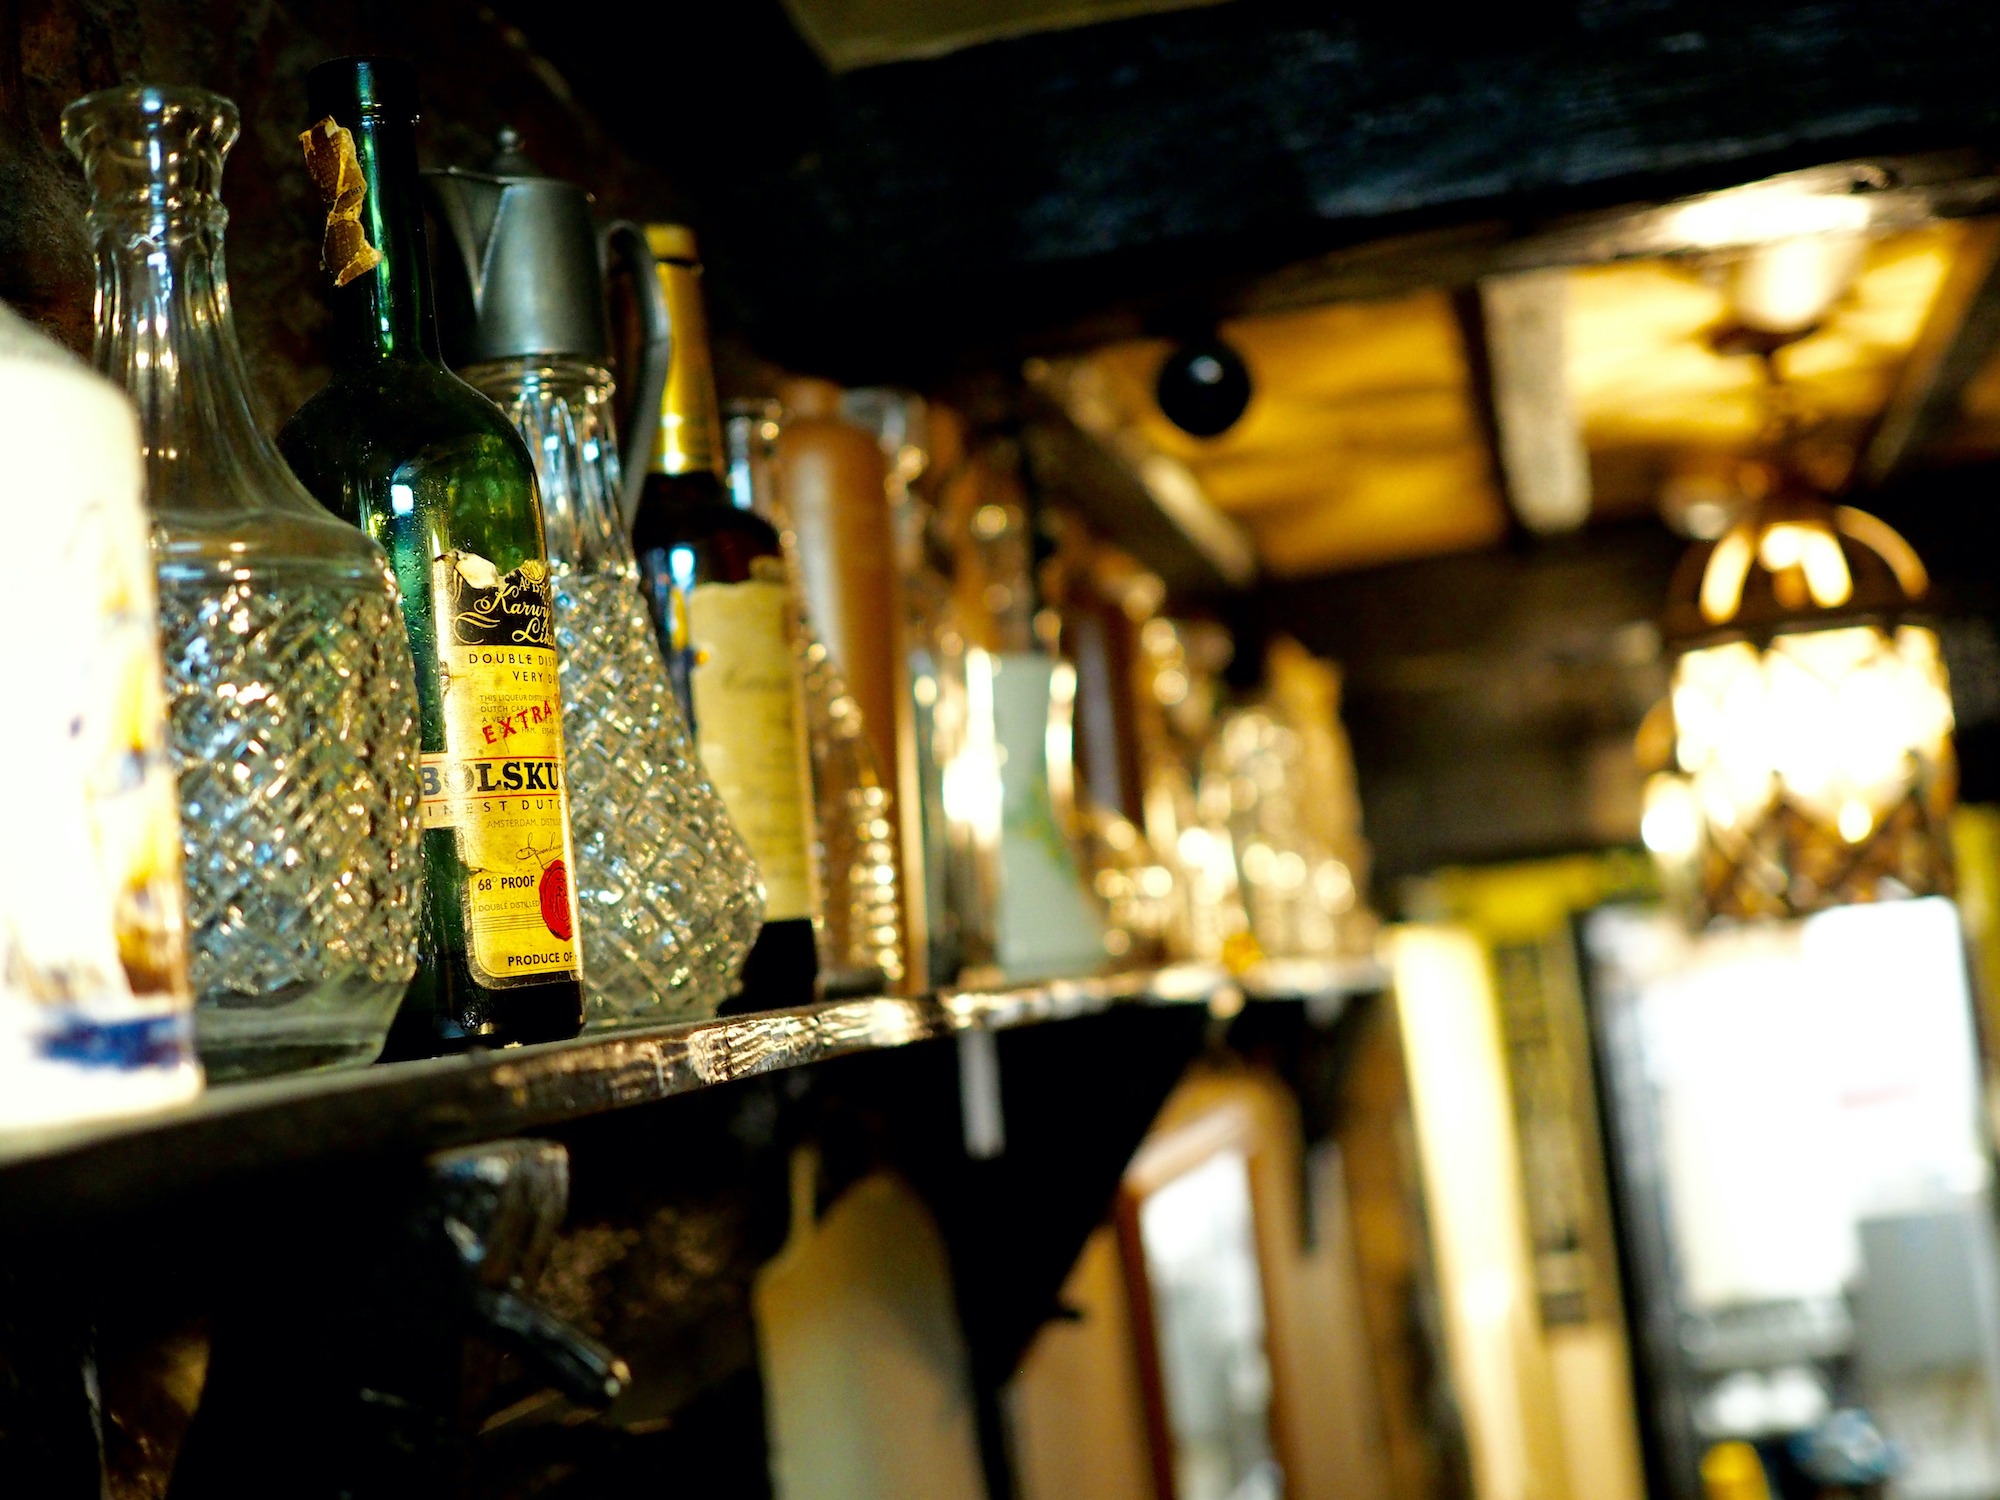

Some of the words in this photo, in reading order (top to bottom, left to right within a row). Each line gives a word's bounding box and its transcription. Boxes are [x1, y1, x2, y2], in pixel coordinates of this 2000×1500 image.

[469, 653, 532, 665] DOUBLE
[512, 670, 543, 683] VERY
[479, 694, 497, 702] THIS
[498, 694, 528, 702] LIQUEUR
[480, 705, 508, 713] DUTCH
[482, 700, 552, 745] EXTRA
[501, 875, 535, 890] PROOF
[478, 902, 508, 912] DOUBLE
[510, 900, 540, 910] DISTILLED
[508, 952, 560, 967] PRODUCE
[563, 951, 573, 962] OF
